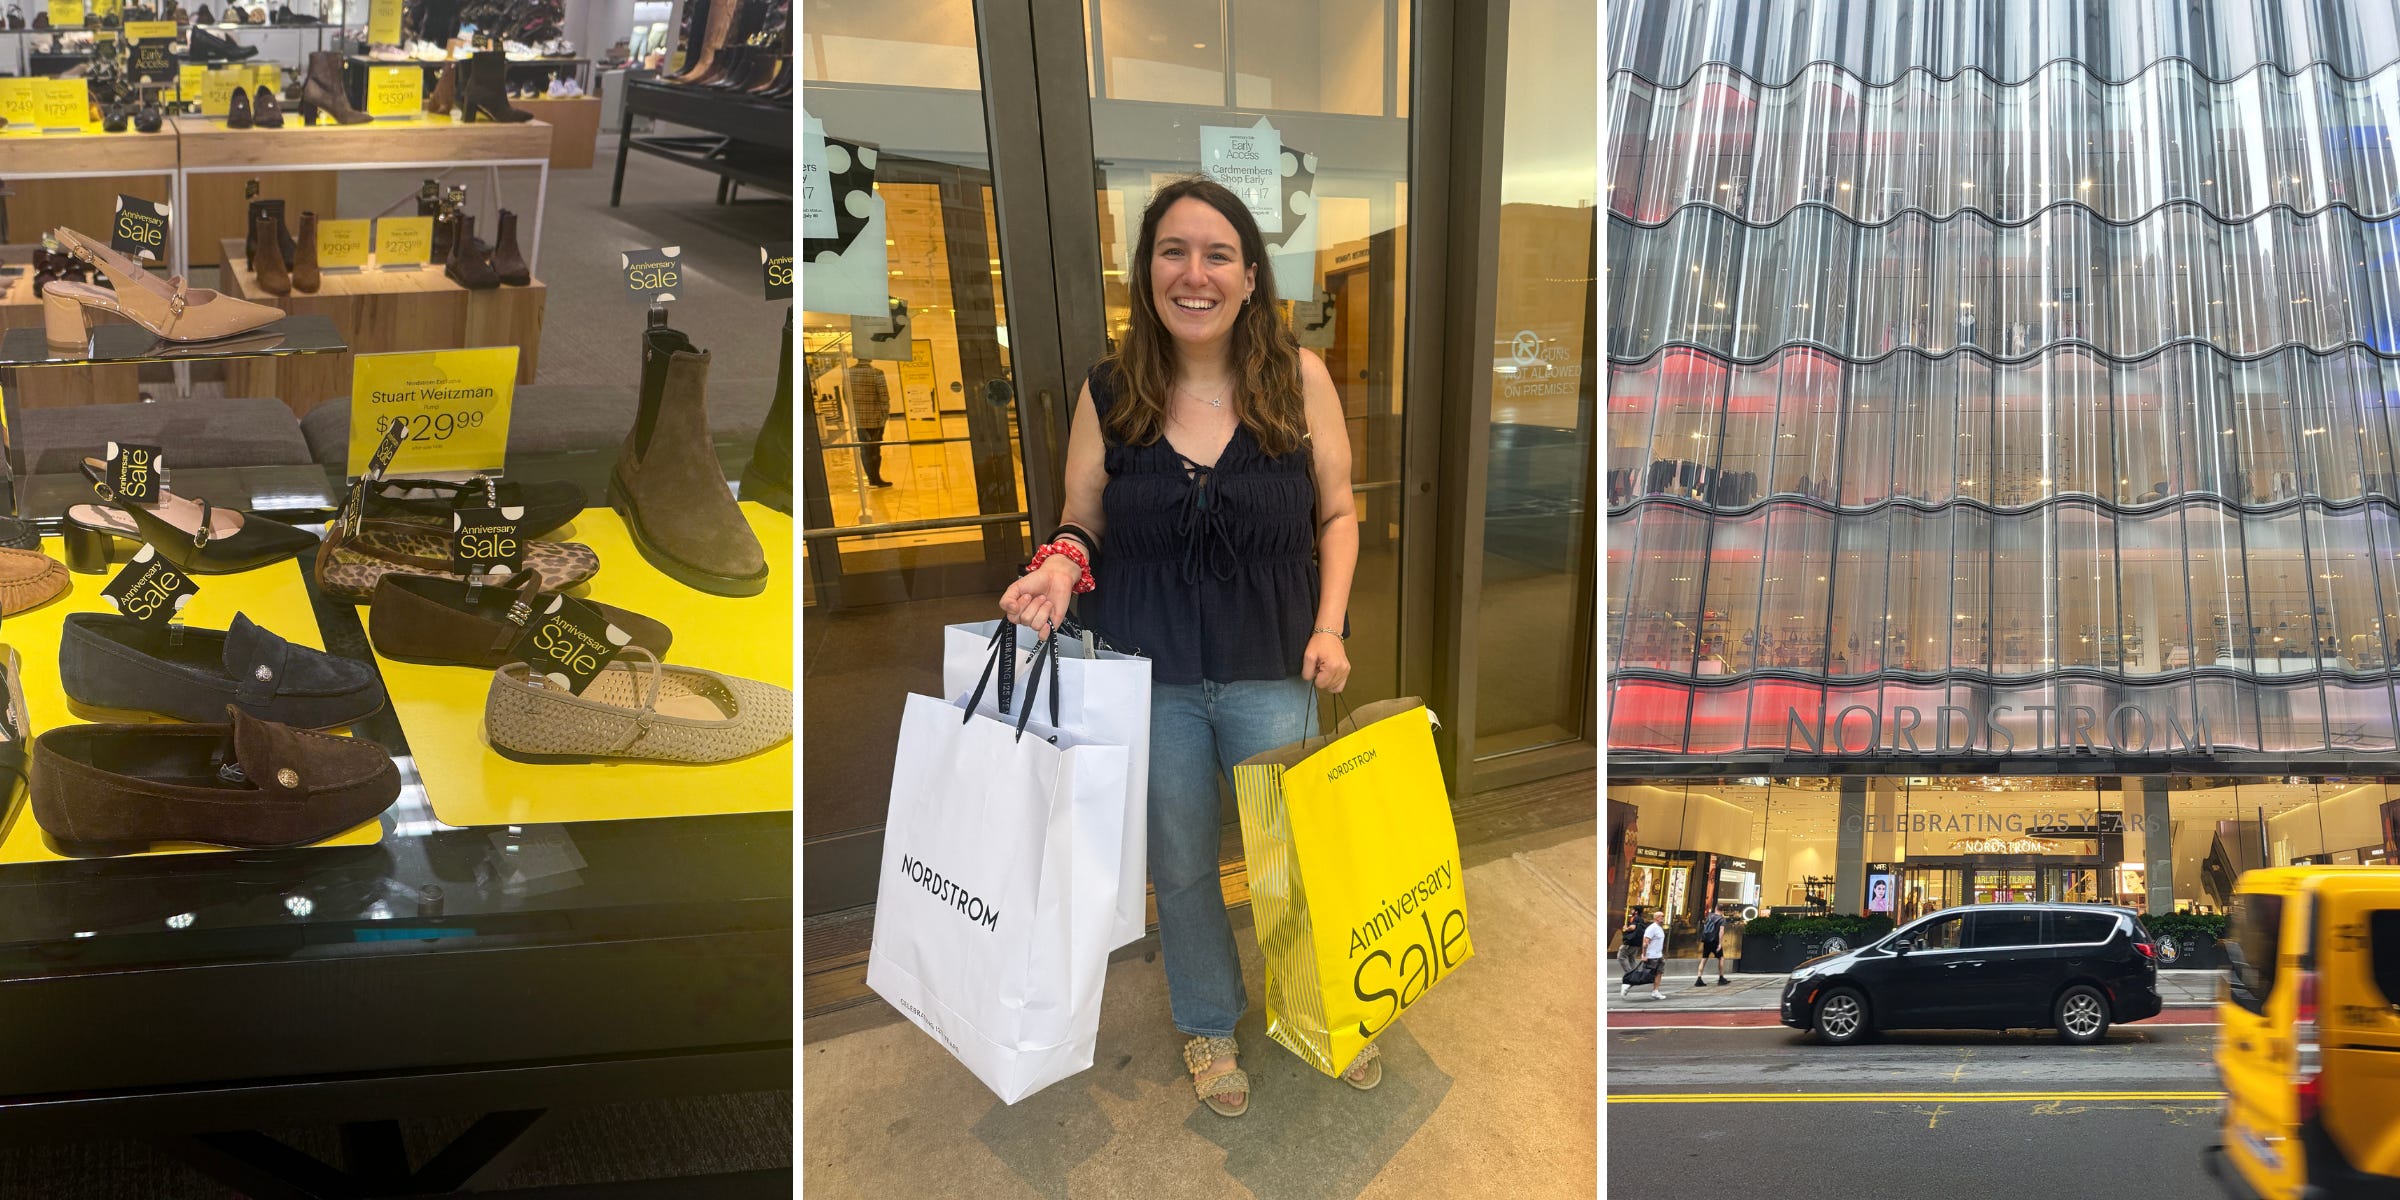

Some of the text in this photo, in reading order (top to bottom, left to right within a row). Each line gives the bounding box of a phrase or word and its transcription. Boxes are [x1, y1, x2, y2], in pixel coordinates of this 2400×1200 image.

[1226, 149, 1259, 160] Access
[1232, 140, 1253, 151] Early
[1212, 164, 1273, 175] Cardmembers
[1220, 174, 1266, 185] Shop Early
[121, 209, 164, 227] Anniversary
[118, 217, 162, 246] Sale
[630, 261, 676, 271] Anniversary
[630, 268, 678, 290] Sale
[1541, 347, 1570, 361] GUNS
[1531, 365, 1582, 379] ALLOWED
[371, 387, 494, 404] Stuart Weitzman
[1504, 382, 1576, 398] ON PREMISES
[118, 448, 130, 496] Anniversary
[126, 449, 149, 498] Sale
[461, 524, 517, 535] Anniversary
[460, 534, 517, 559] Sale
[120, 561, 162, 606] Anniversary
[128, 572, 180, 621] Sale
[550, 615, 610, 655] Anniversary
[533, 623, 597, 676] Sale
[1785, 704, 2215, 757] NORDSTROM
[1327, 748, 1377, 783] NORDSTROM
[1847, 813, 2022, 833] CELEBRATING
[2033, 813, 2069, 833] 125
[2079, 813, 2161, 833] YEARS
[1965, 839, 2041, 855] NORDSTROM
[901, 853, 1000, 933] NORDSTROM
[1349, 860, 1453, 959] Anniversary
[1353, 908, 1468, 1039] Sale
